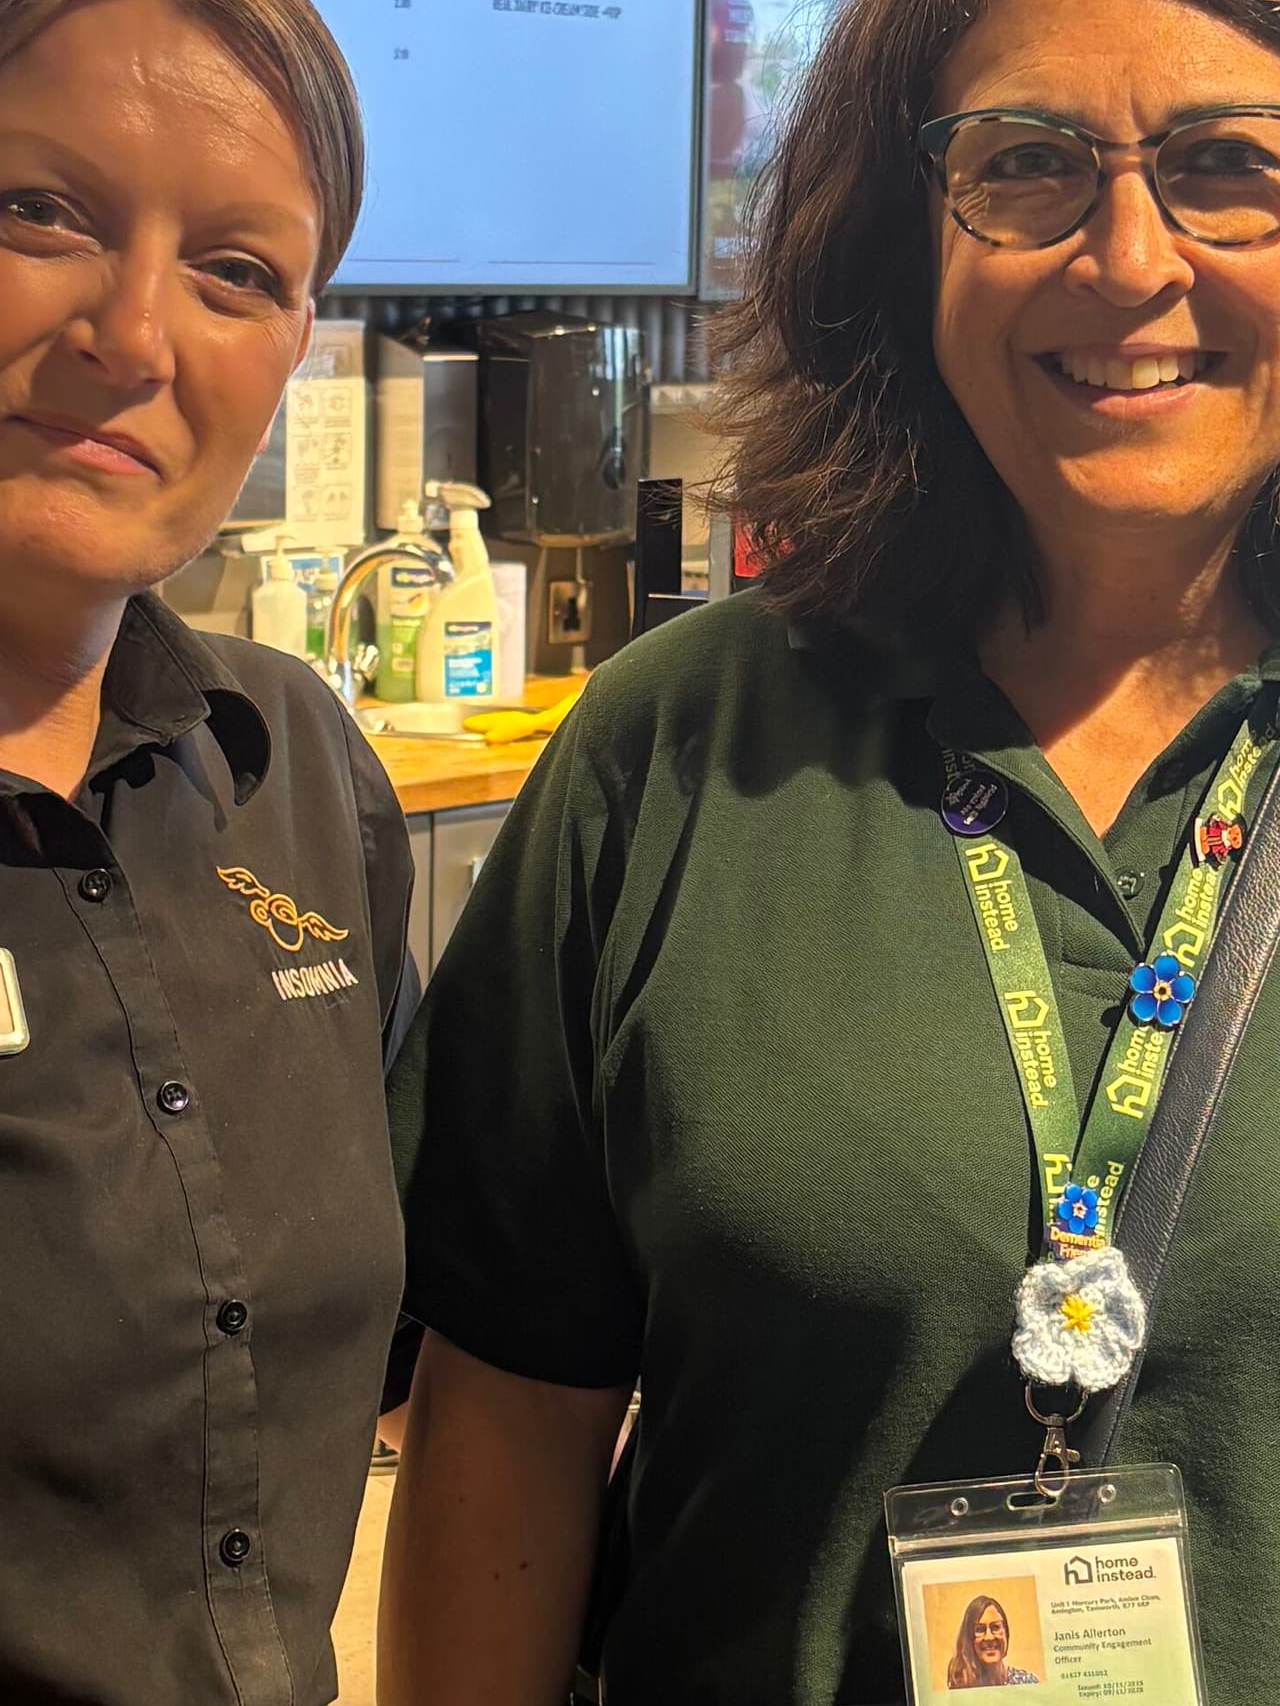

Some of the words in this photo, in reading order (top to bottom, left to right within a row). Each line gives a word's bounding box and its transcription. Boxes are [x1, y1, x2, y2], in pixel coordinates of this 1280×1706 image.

[991, 880, 1019, 933] home
[1175, 868, 1203, 920] home
[270, 959, 360, 1001] INSOMNIA
[1031, 1030, 1057, 1088] home
[1095, 1554, 1139, 1569] home
[1053, 1629, 1080, 1641] Janis
[1083, 1626, 1126, 1639] Allerton
[1053, 1642, 1100, 1653] Community
[1101, 1637, 1152, 1650] Engagement
[1055, 1654, 1082, 1665] Officer
